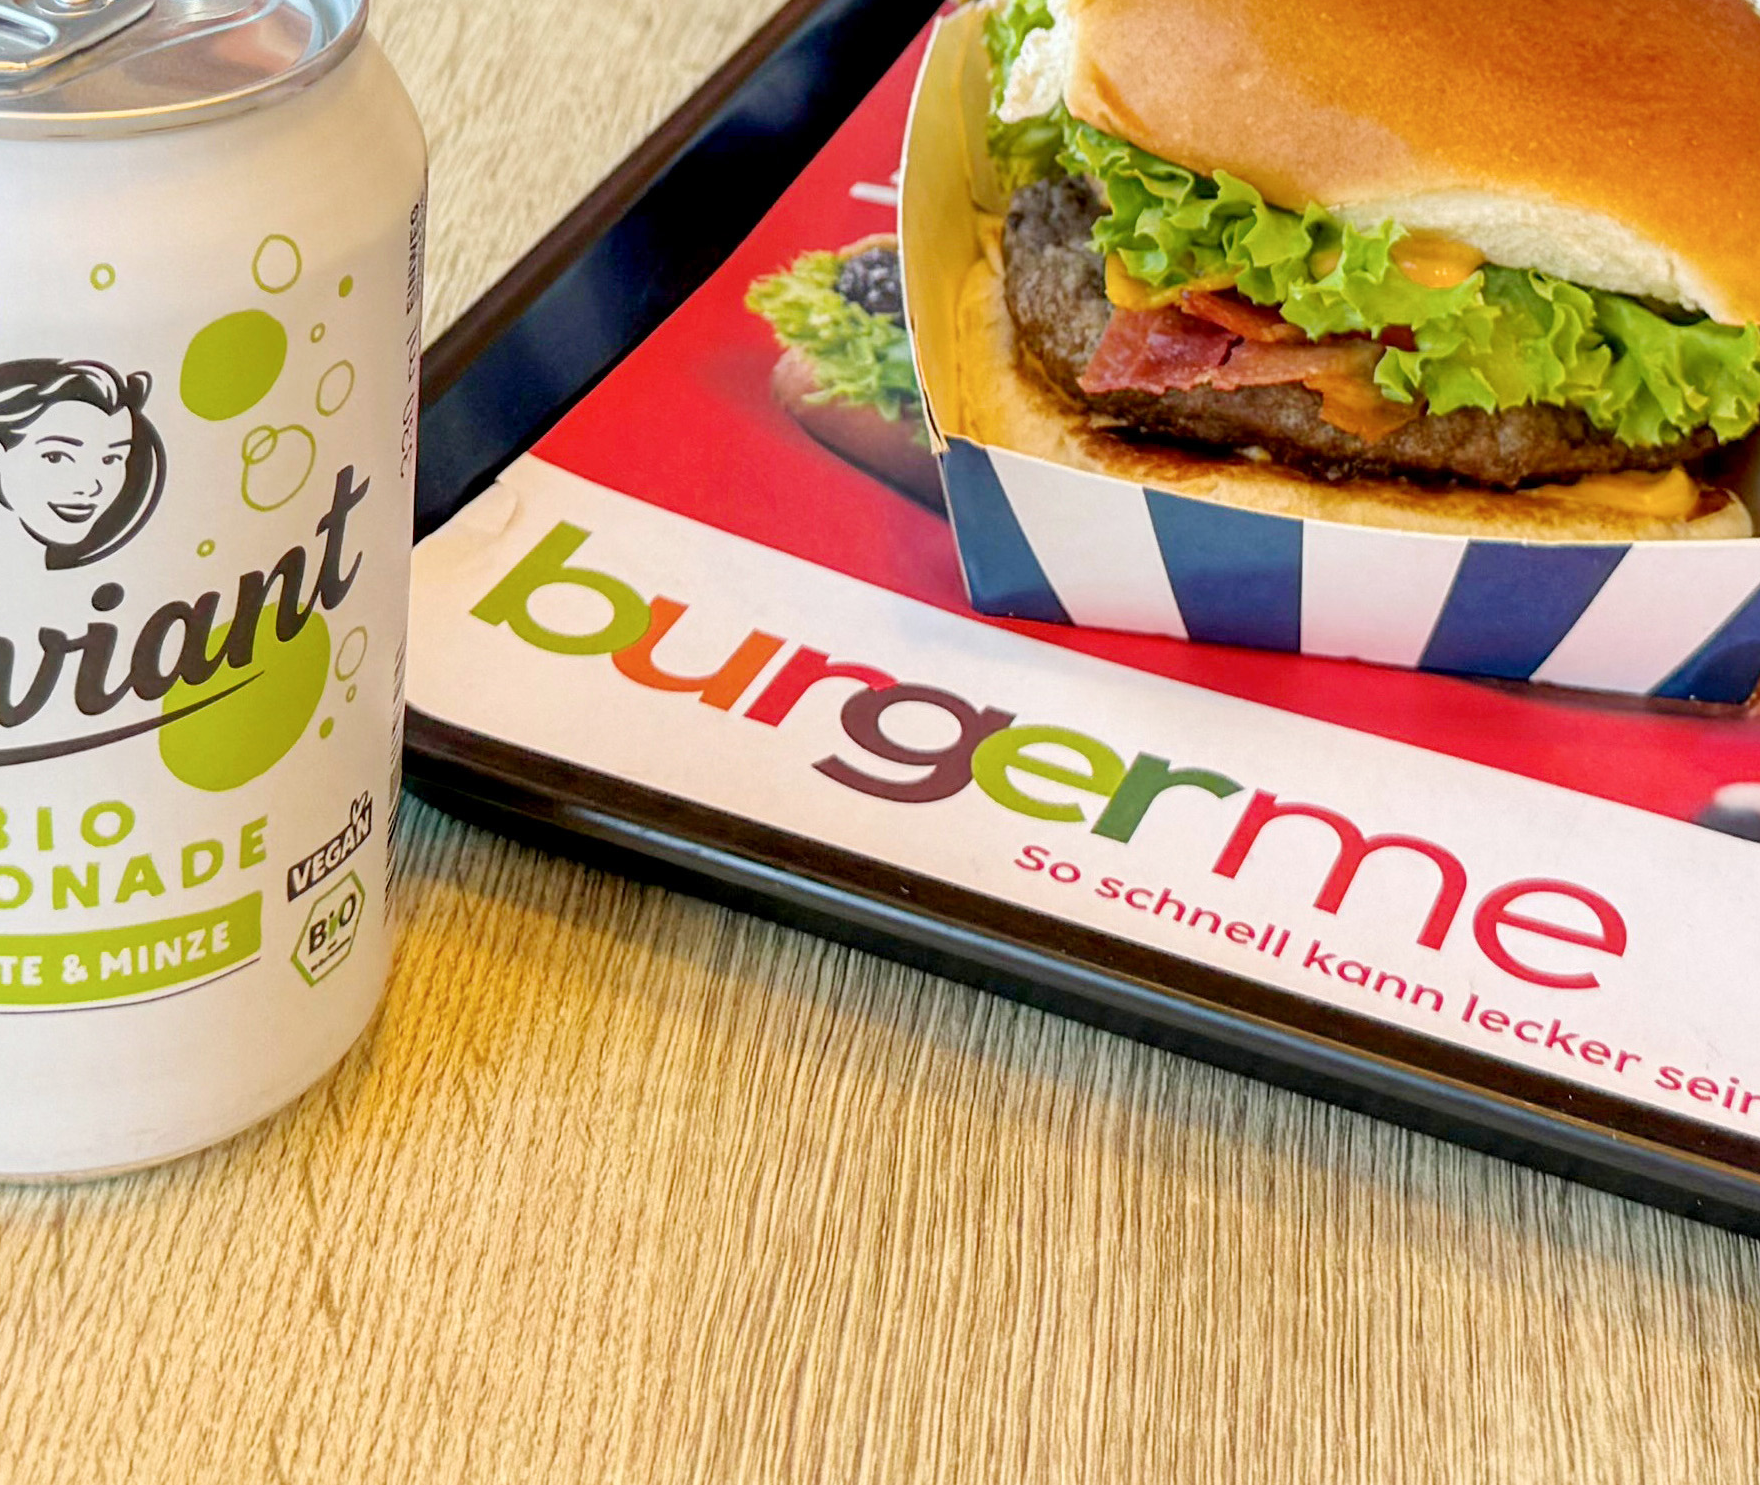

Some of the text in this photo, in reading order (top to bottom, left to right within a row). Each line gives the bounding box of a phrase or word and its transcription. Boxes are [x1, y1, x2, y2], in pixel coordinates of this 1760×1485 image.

[469, 521, 1628, 993] burgerme
[291, 810, 372, 894] VEGAN
[61, 956, 88, 985] &
[100, 919, 231, 981] MINZE
[1015, 841, 1080, 886] So
[1095, 871, 1291, 959] schnell
[1304, 937, 1443, 1012] kann
[1460, 993, 1641, 1080] lecker
